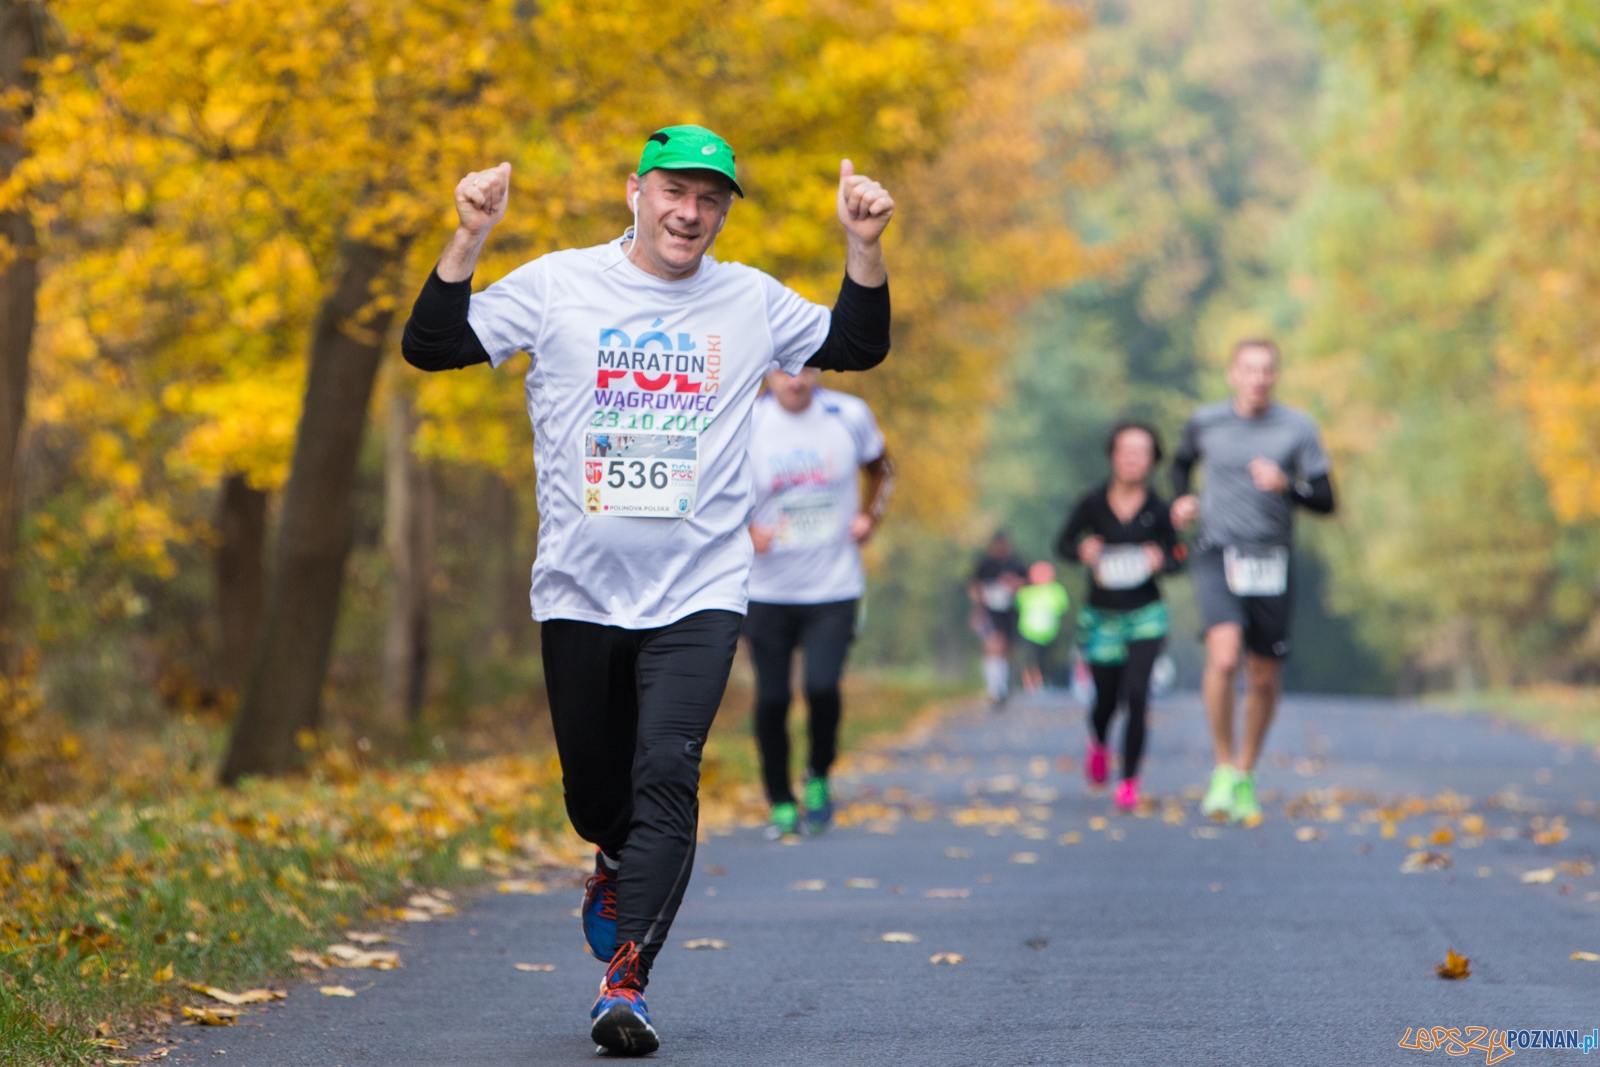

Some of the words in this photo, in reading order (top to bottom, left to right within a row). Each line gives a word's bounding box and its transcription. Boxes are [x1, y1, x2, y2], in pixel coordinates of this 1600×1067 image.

[597, 350, 705, 373] MARATON
[704, 334, 721, 393] SKOKI
[594, 390, 717, 412] WĄGROWIEC
[607, 460, 668, 490] 536
